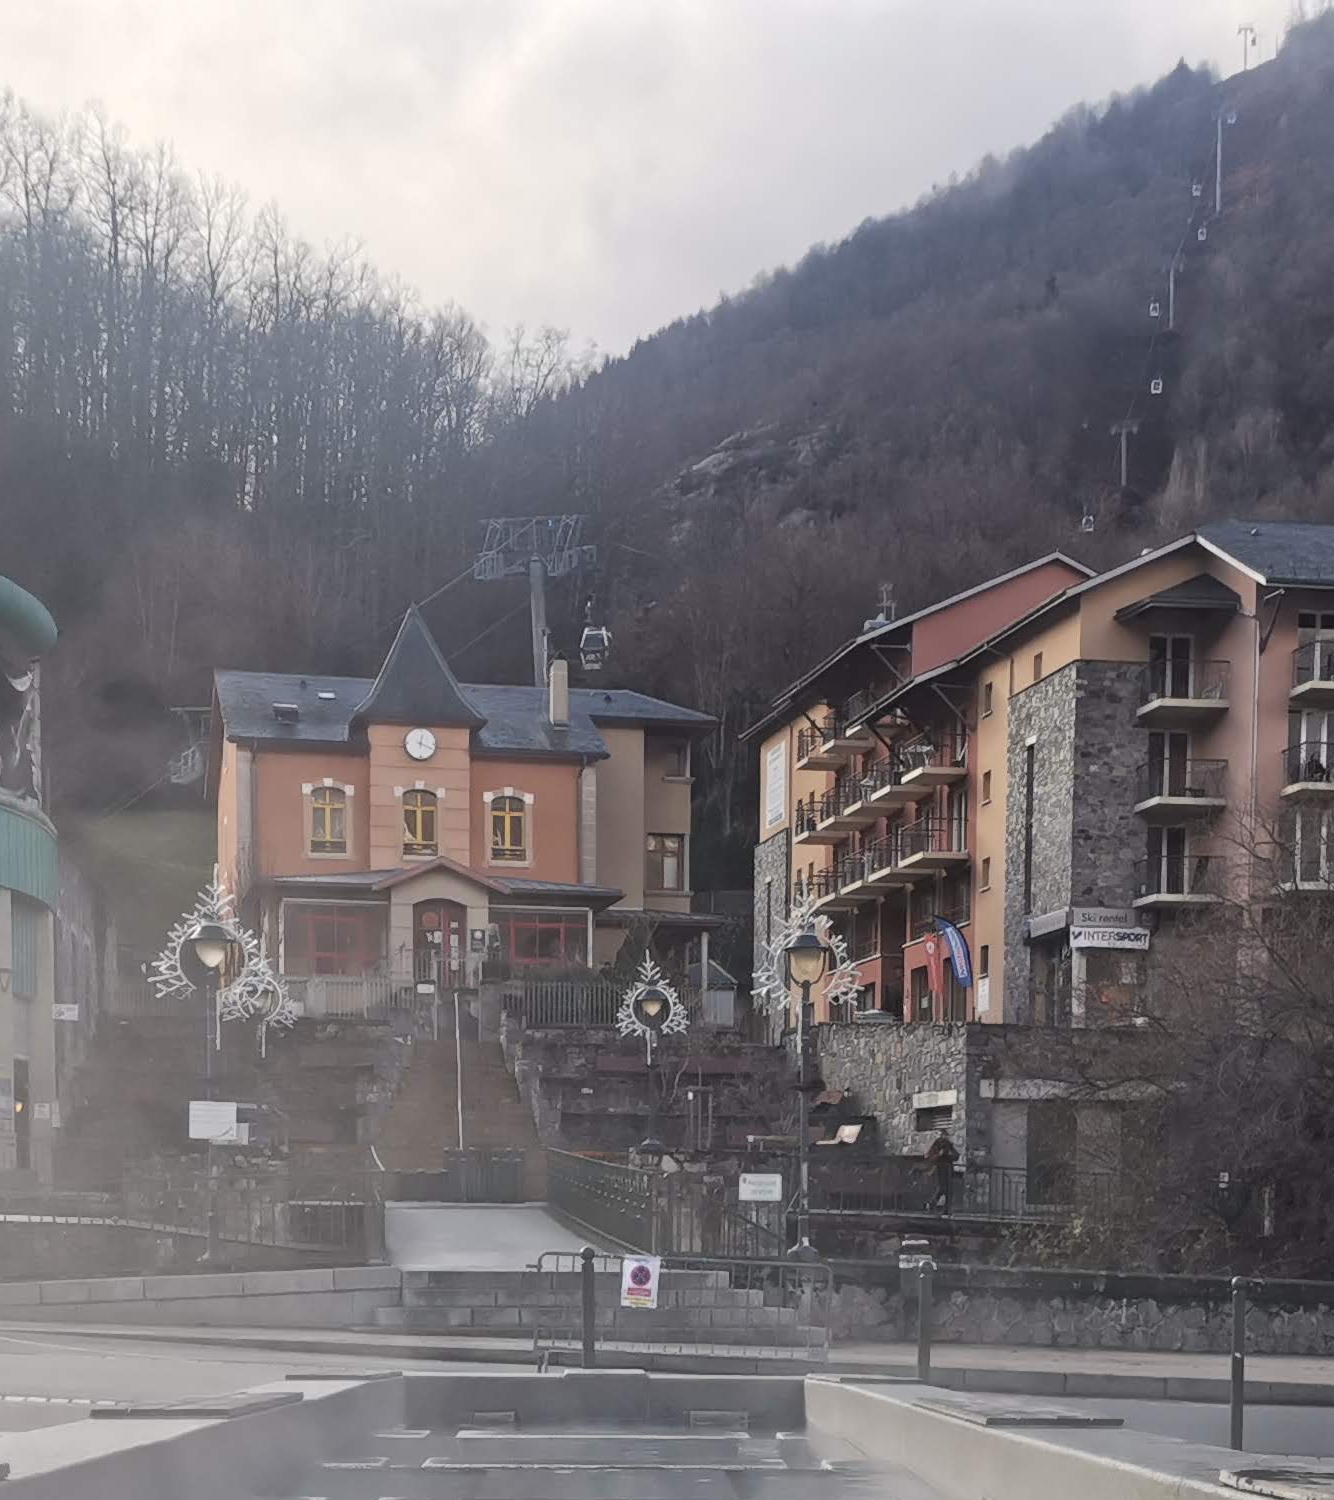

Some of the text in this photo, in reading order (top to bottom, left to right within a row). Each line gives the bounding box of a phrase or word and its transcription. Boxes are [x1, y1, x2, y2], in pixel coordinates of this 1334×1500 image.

[1081, 912, 1128, 922] Ski rental
[1083, 930, 1148, 943] INTERSPORT
